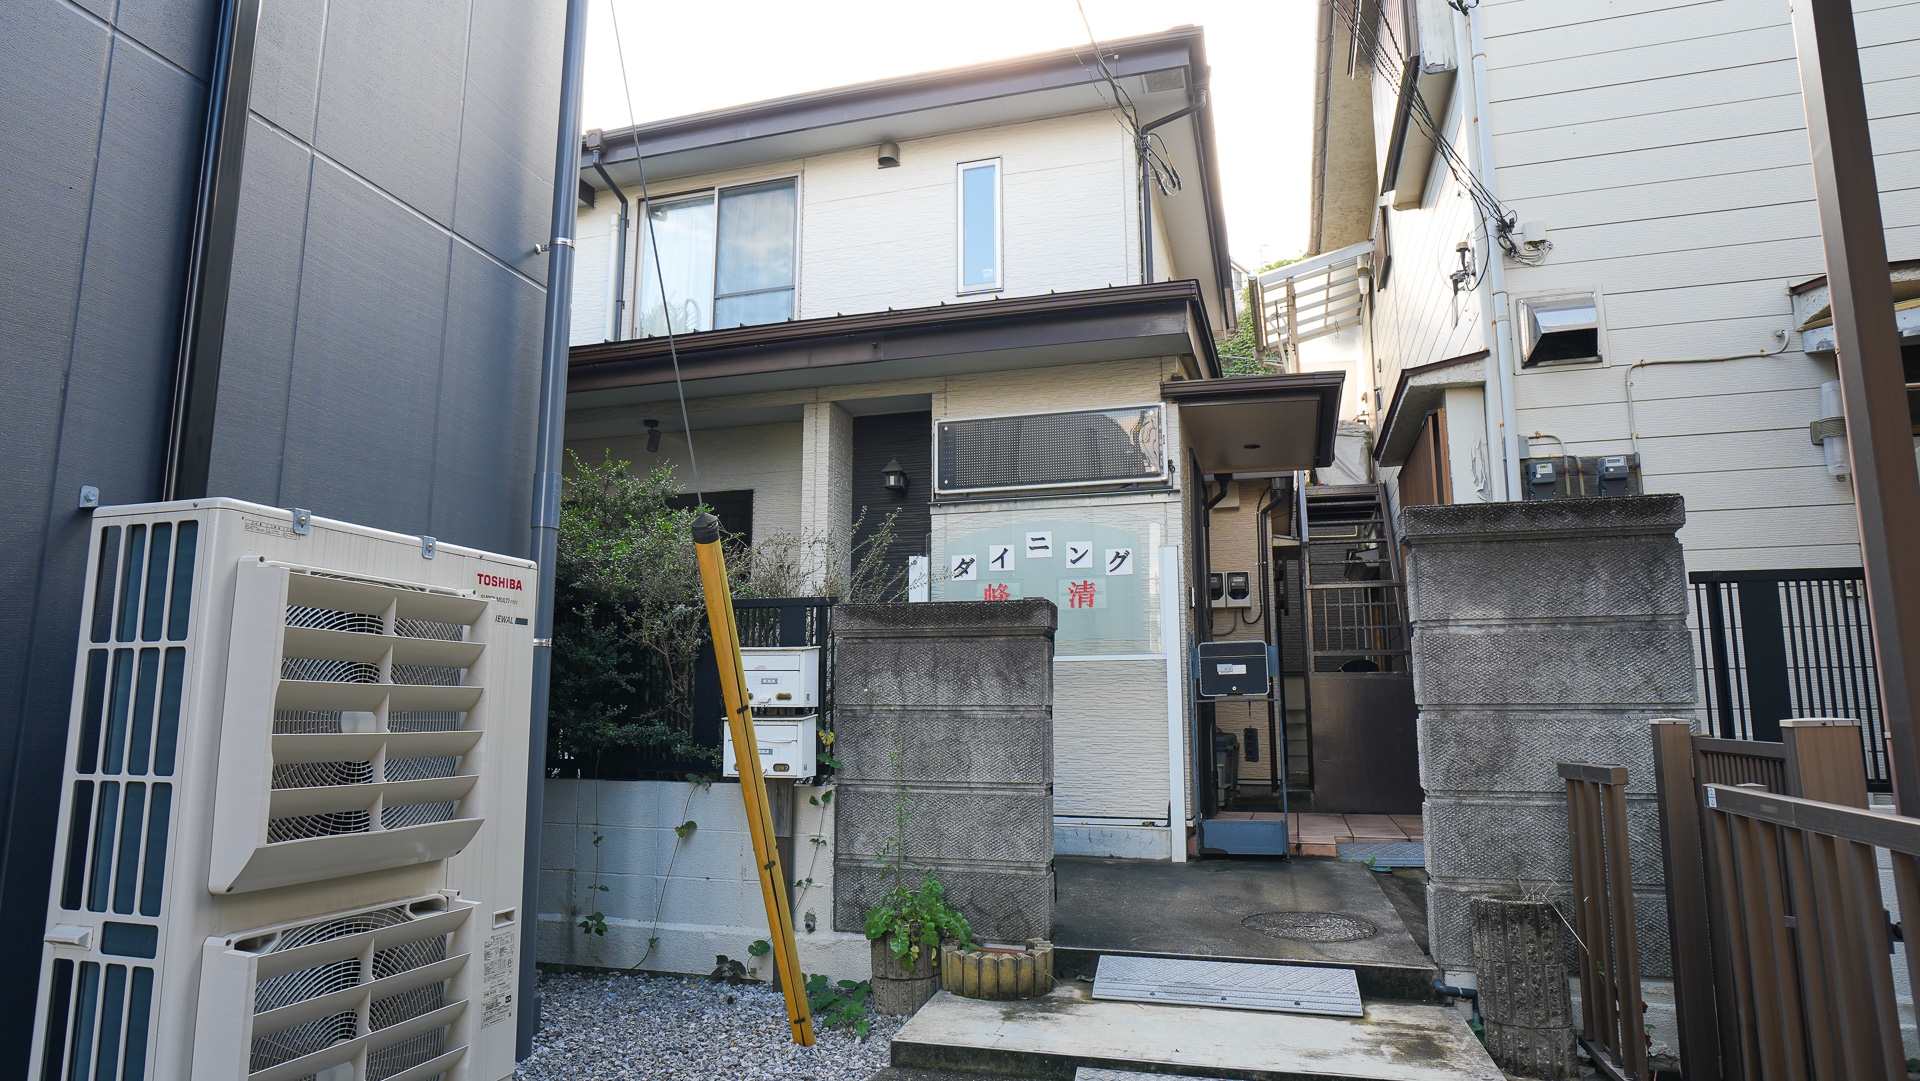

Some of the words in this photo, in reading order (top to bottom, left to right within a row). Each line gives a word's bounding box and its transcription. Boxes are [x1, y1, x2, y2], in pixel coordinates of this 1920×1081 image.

[954, 536, 1130, 578] ダイニング
[477, 573, 522, 591] TOSHIBA
